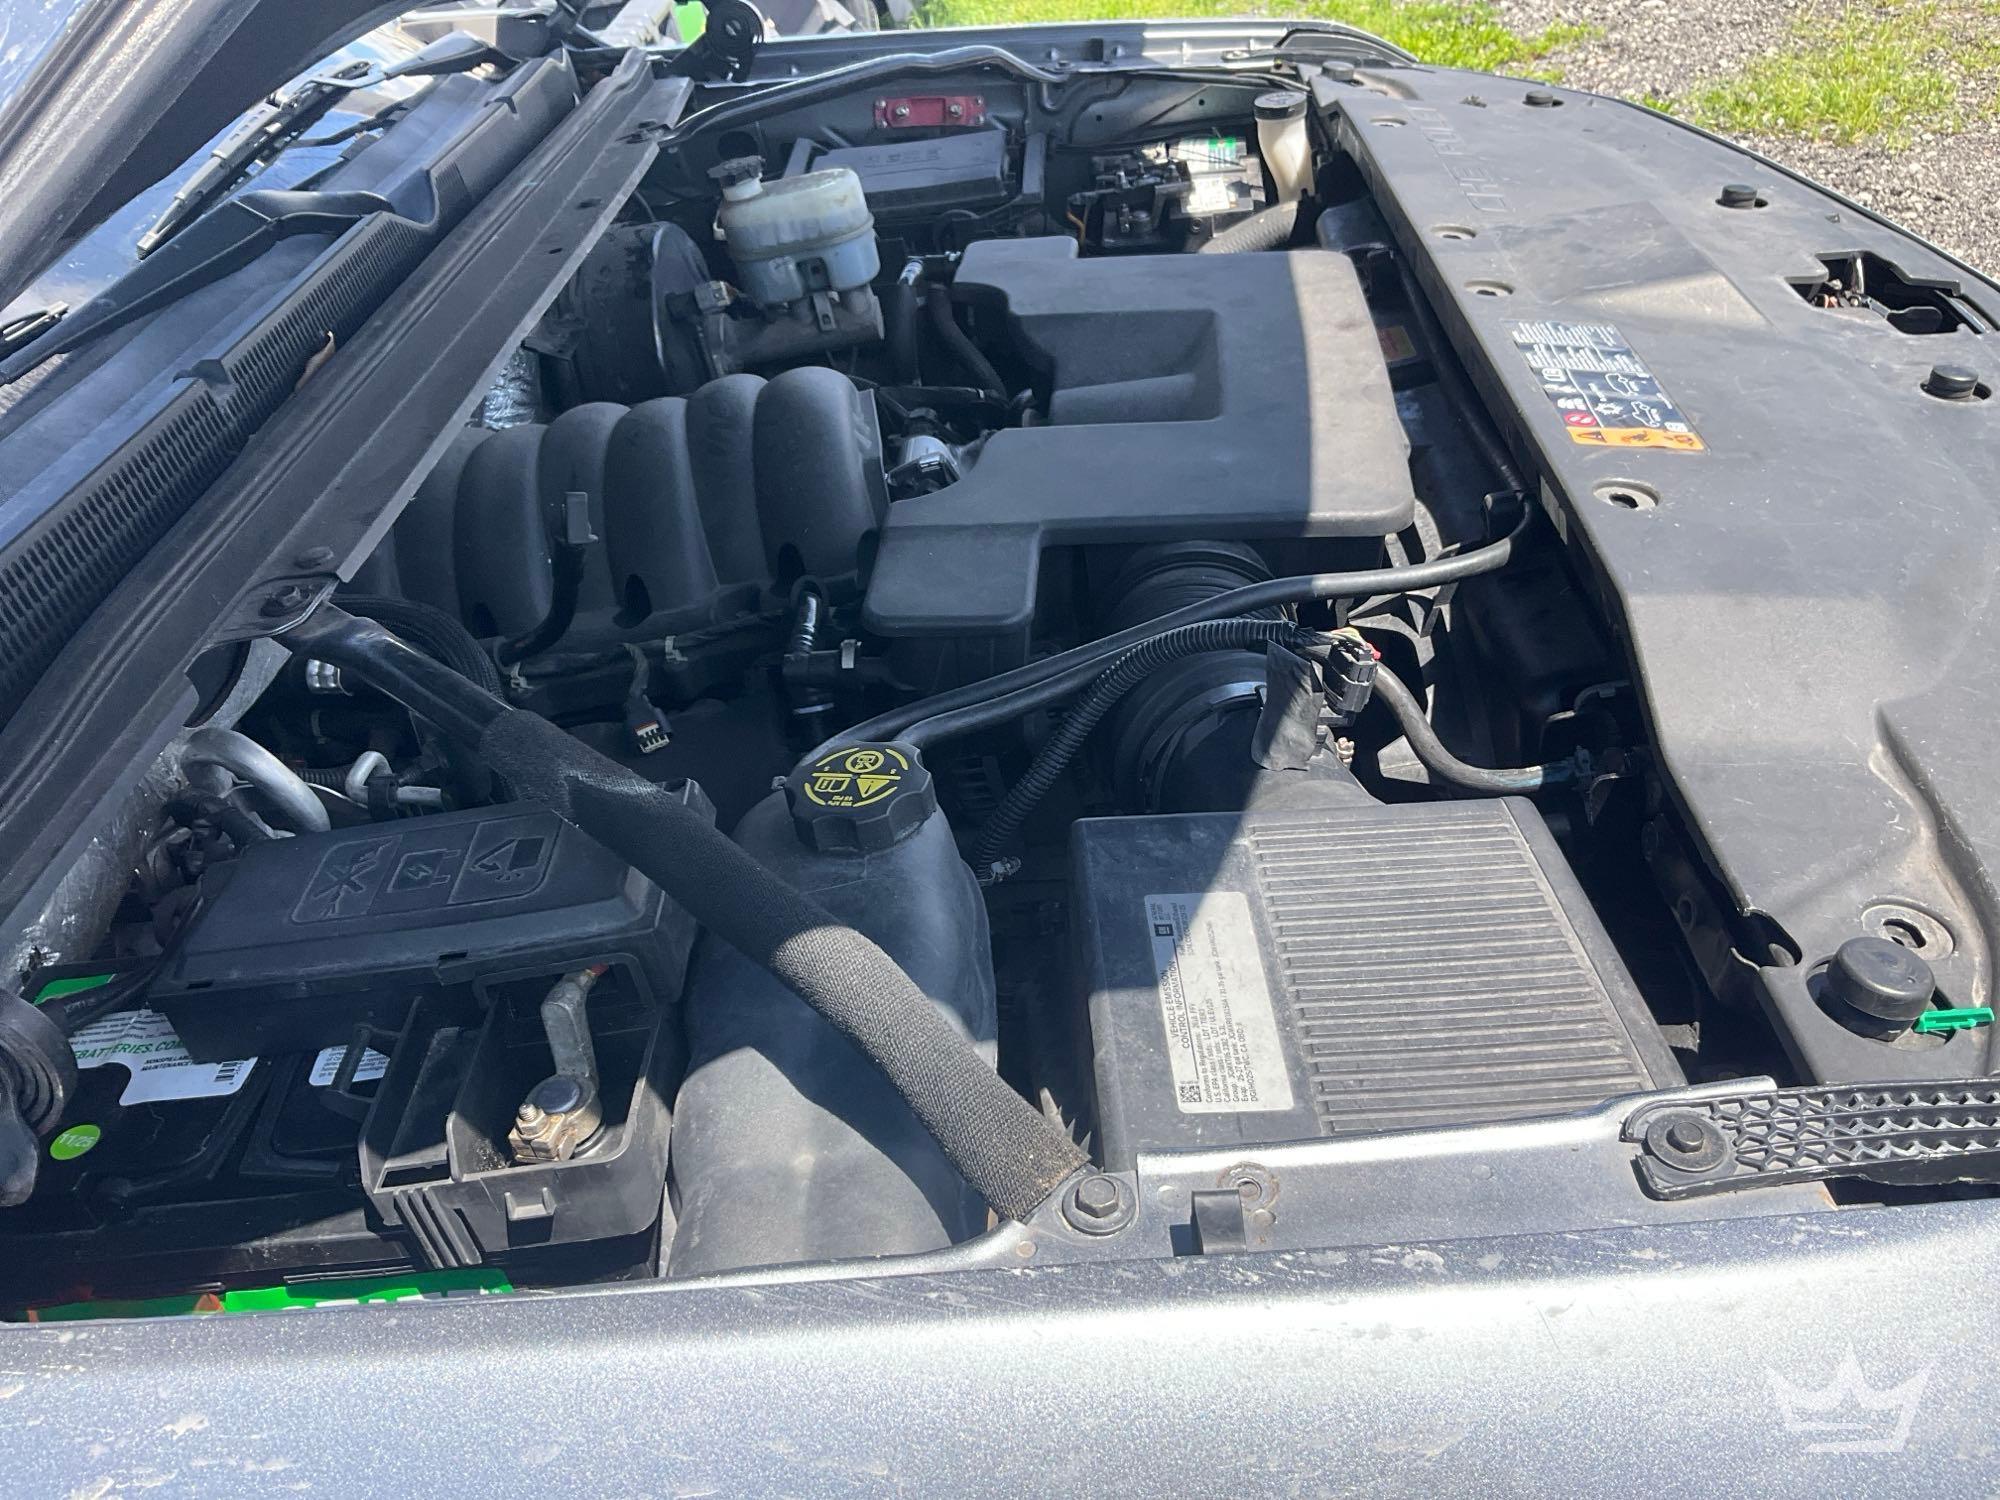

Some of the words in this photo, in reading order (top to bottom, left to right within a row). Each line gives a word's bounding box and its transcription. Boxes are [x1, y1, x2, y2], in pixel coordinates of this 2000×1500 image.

[1160, 969, 1173, 1004] EMISSION
[1167, 961, 1183, 1009] INFORMATION
[1166, 1005, 1179, 1037] VEHICLE
[1176, 1011, 1190, 1048] CONTROL
[1208, 1061, 1216, 1075] class
[1211, 1077, 1219, 1088] EPA
[1219, 1074, 1231, 1102] California
